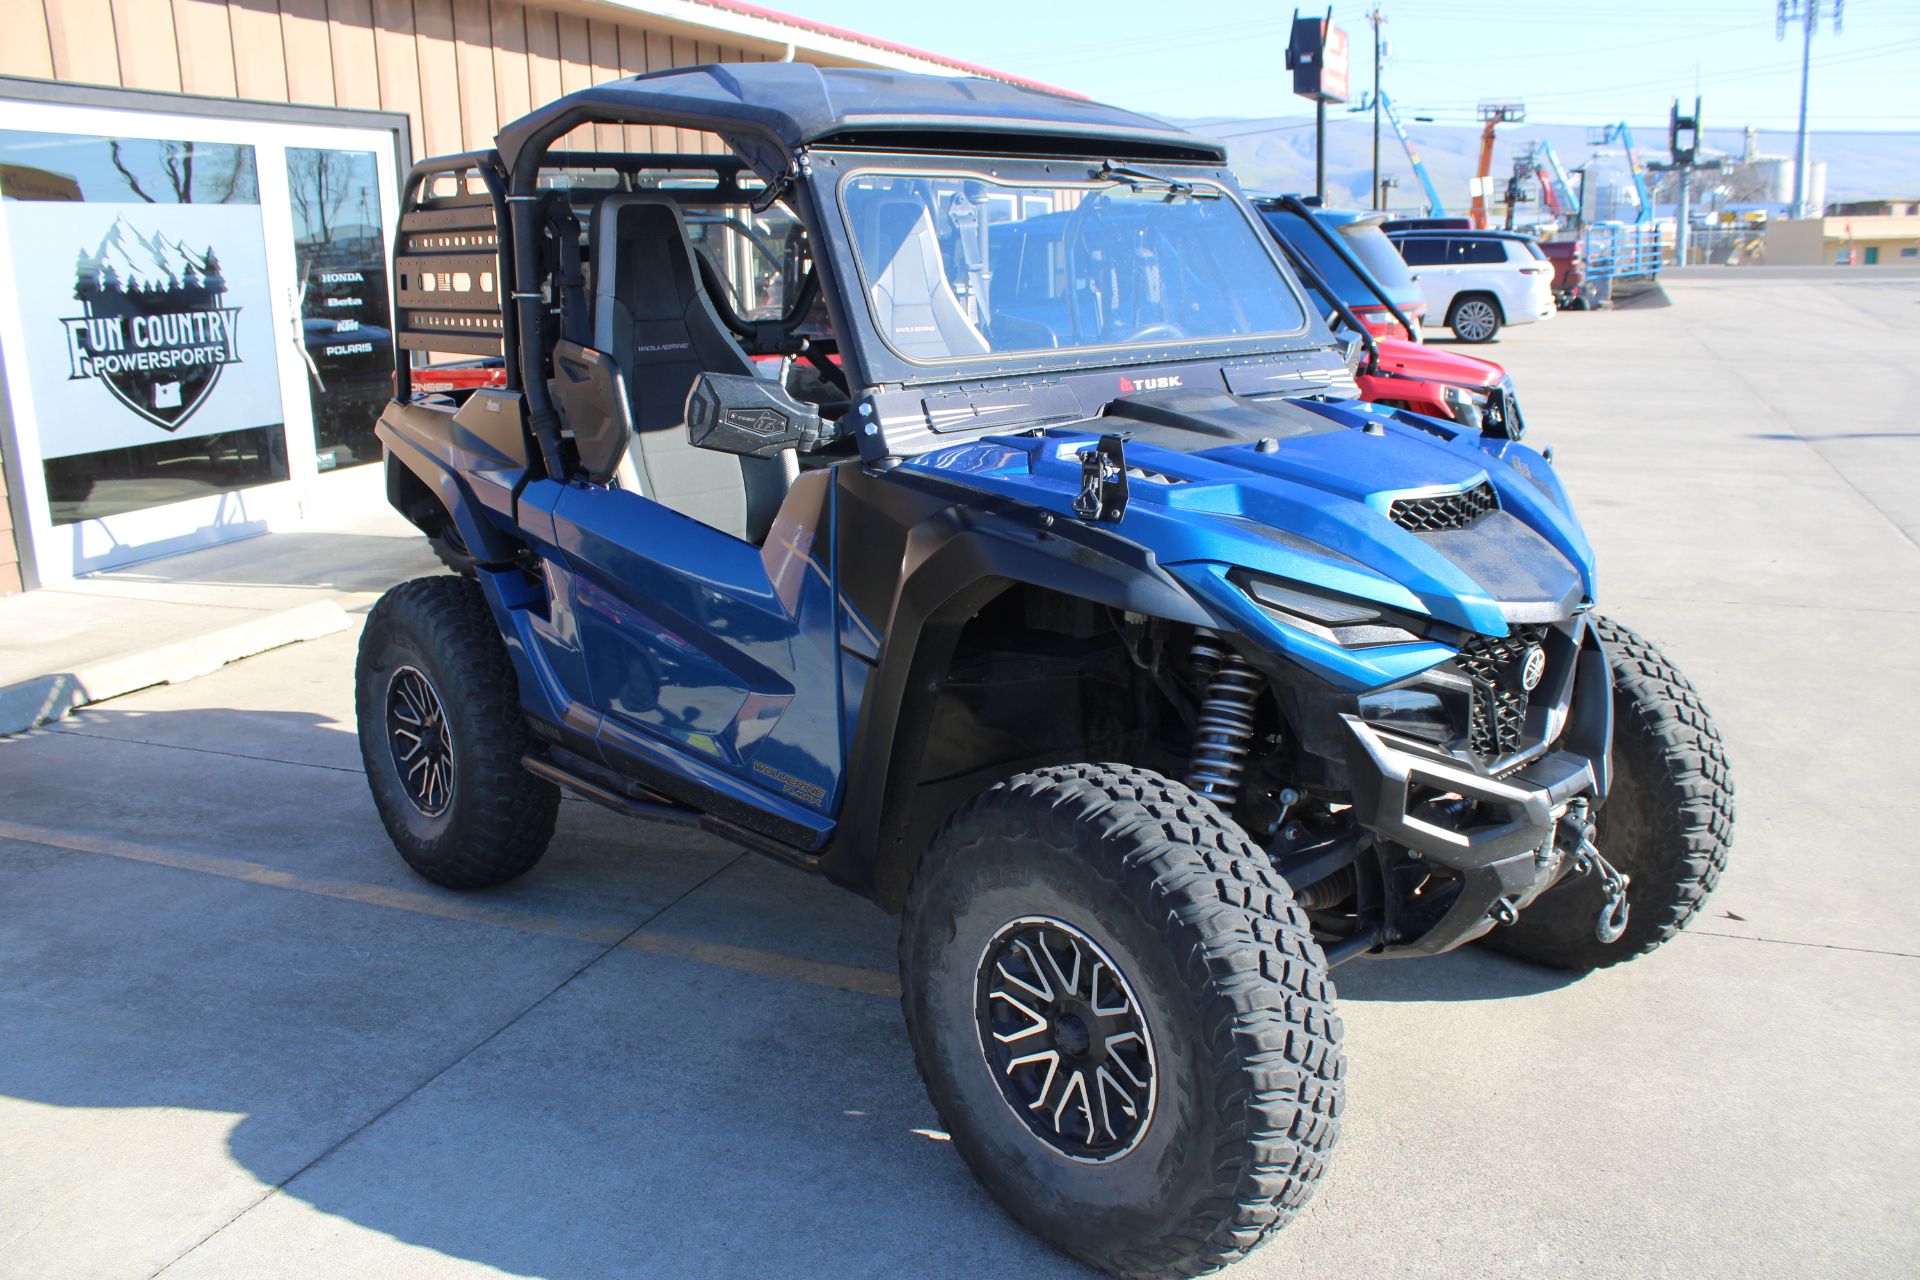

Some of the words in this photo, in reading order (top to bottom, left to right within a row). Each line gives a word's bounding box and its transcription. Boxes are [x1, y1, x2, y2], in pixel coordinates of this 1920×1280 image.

[321, 272, 364, 282] HONDA
[327, 297, 363, 307] Beta
[66, 316, 125, 378] FUN
[132, 309, 240, 361] COUNTRY
[326, 343, 373, 357] POLARIS
[92, 346, 225, 375] POWERSPORTS
[1132, 375, 1183, 391] TUSK
[753, 761, 826, 799] WOLVERINE
